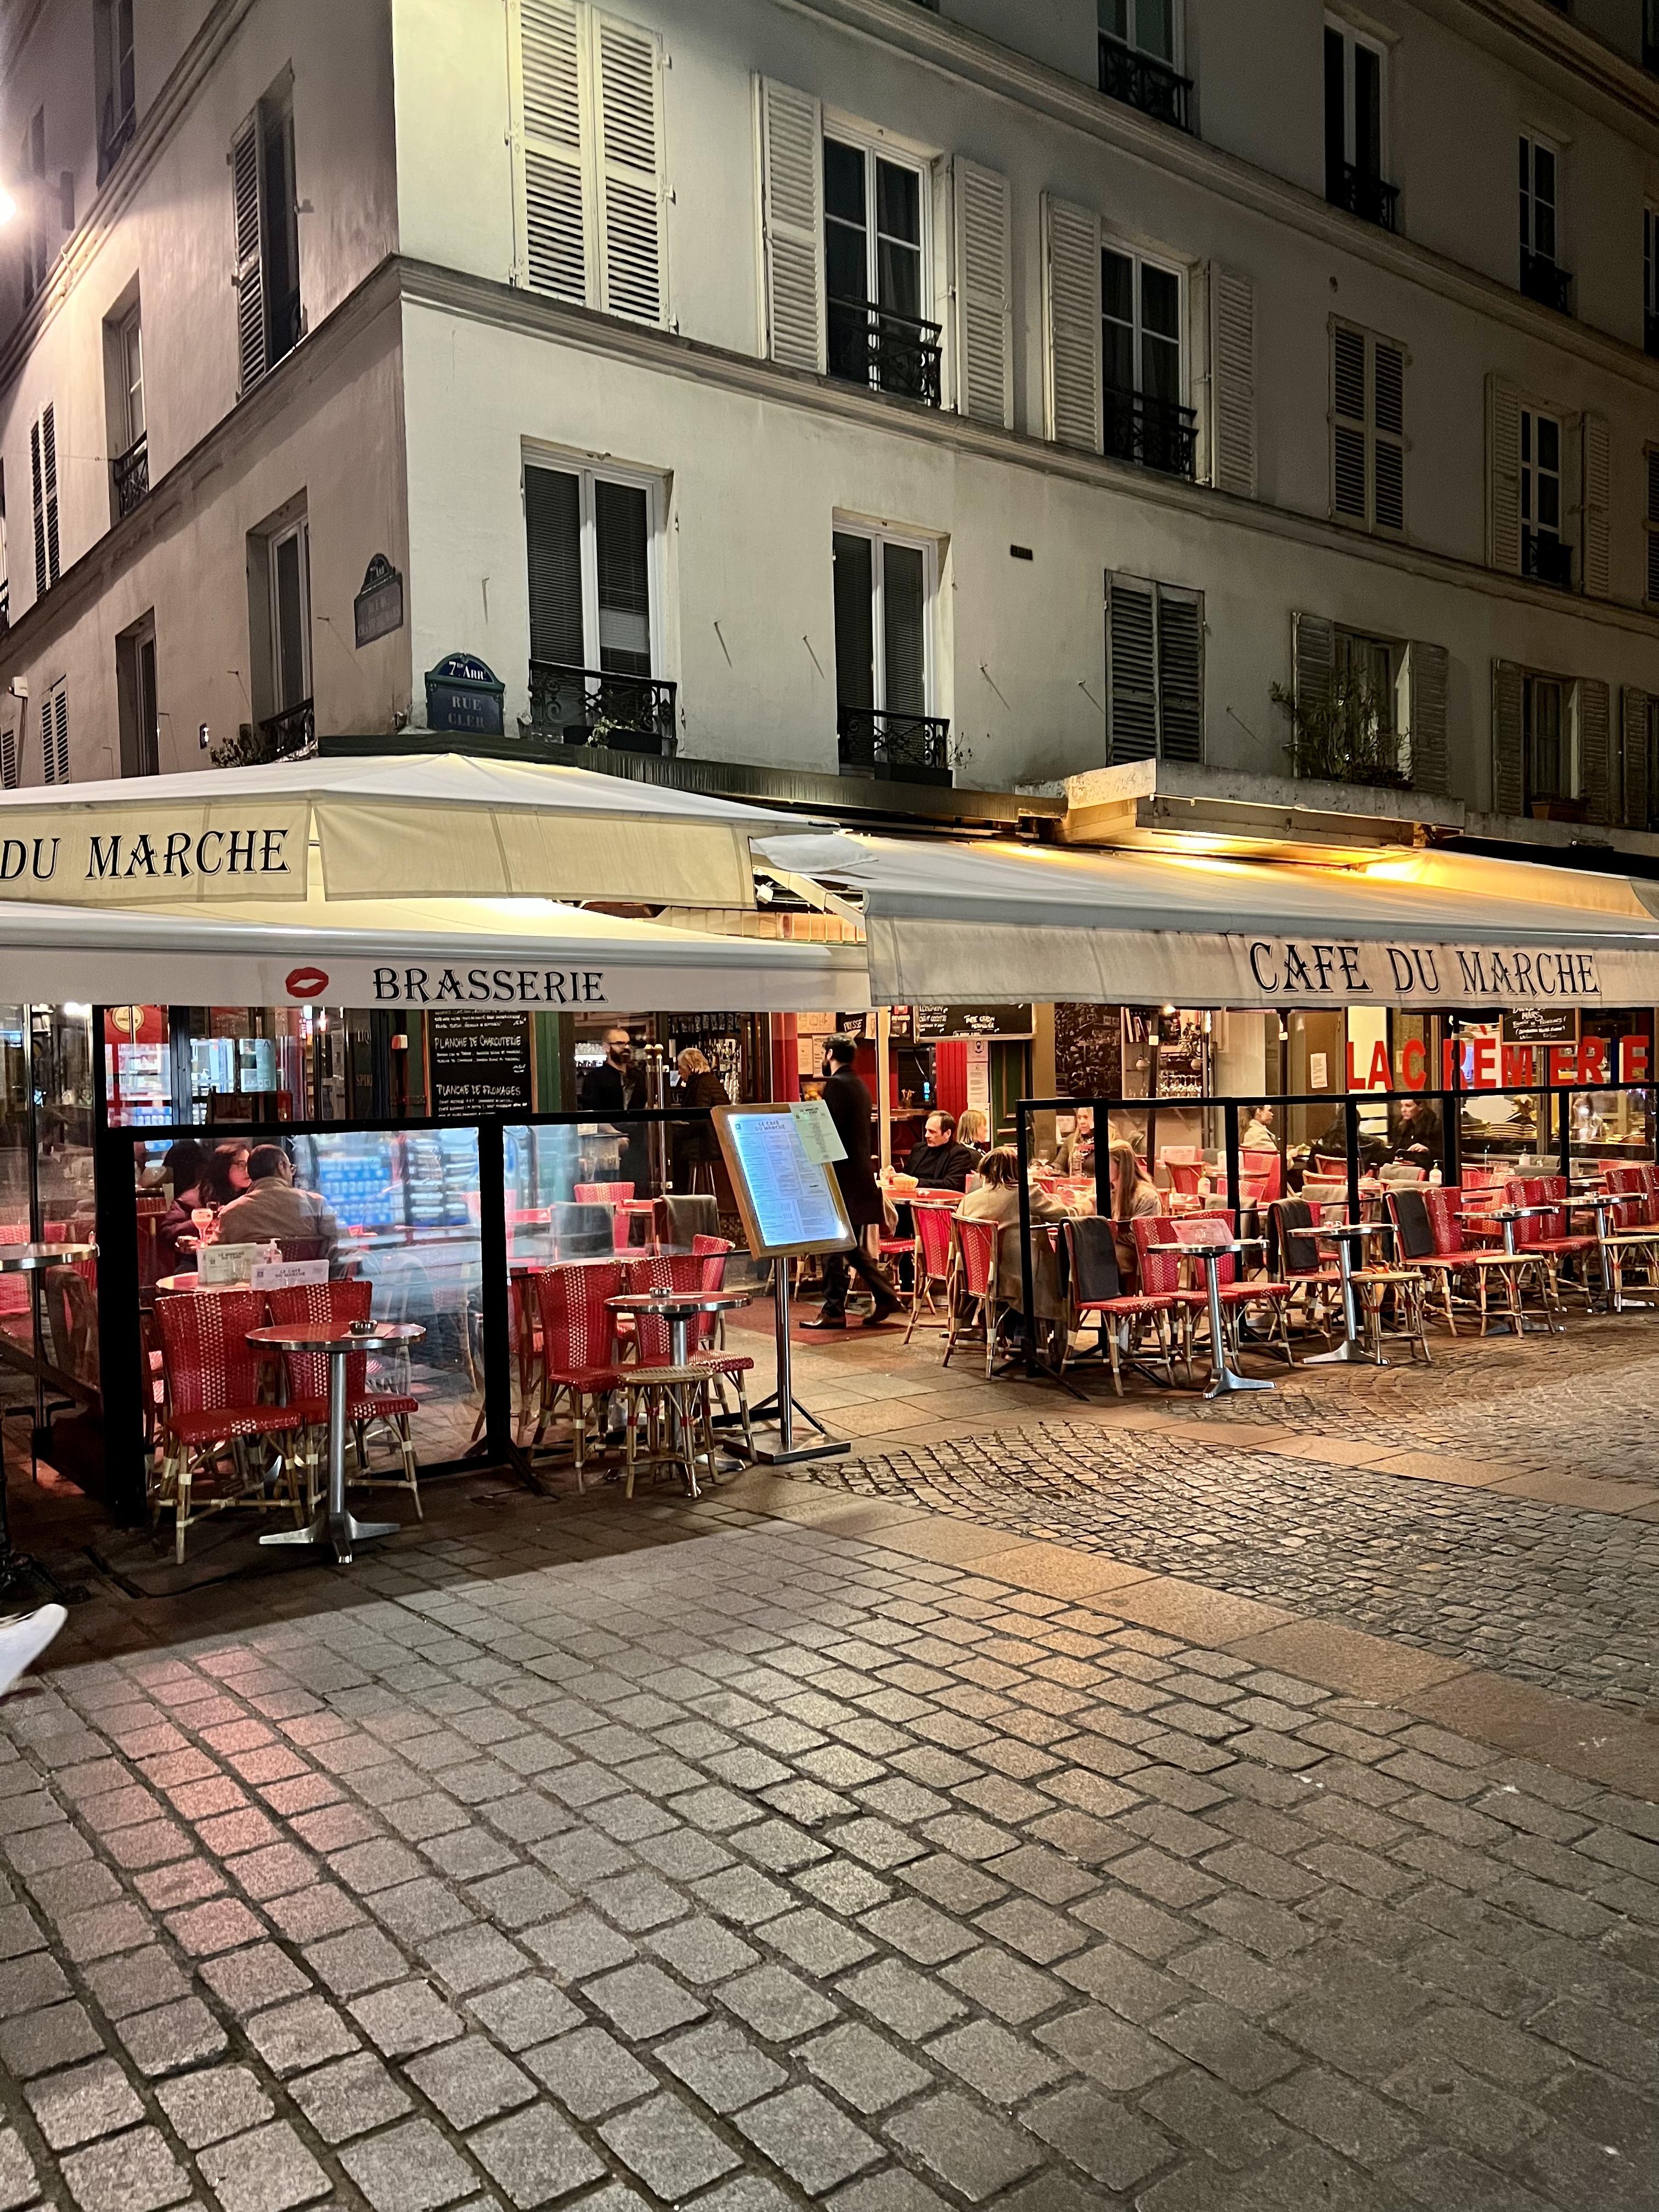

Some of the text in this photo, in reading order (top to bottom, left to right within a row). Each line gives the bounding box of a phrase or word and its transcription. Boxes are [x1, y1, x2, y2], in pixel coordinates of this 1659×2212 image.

[452, 695, 481, 711] RUE
[448, 713, 484, 729] CLER
[0, 829, 291, 881] DU MARCHE
[1250, 942, 1602, 998] CAFE DU MARCHE
[373, 968, 608, 1005] BRASSERIE
[844, 1019, 863, 1032] PRESSE
[435, 1037, 467, 1050] PLANCHE
[469, 1036, 478, 1047] DE
[1347, 1041, 1393, 1091] LA
[436, 1084, 521, 1096] PLANCHE DE FROMAGES
